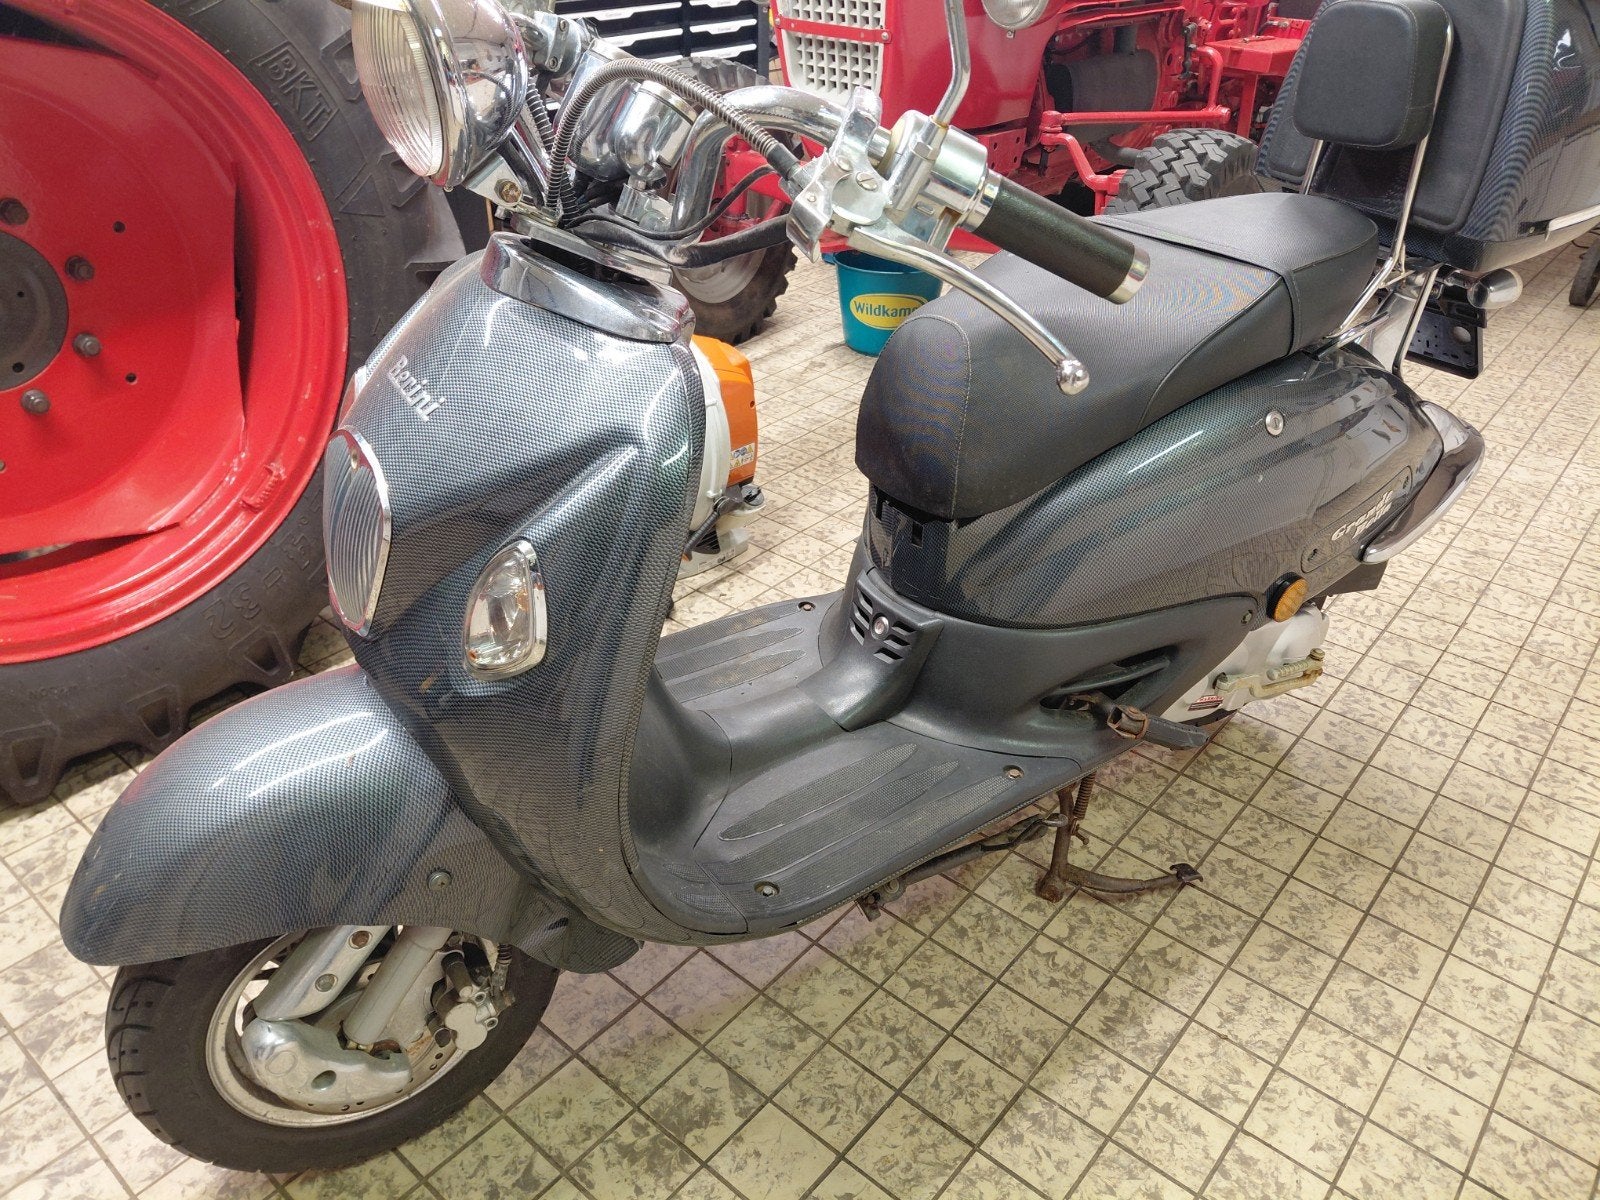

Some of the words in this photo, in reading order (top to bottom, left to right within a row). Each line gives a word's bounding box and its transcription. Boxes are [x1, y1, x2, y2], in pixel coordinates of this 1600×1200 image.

[258, 46, 332, 129] BKT
[853, 300, 919, 318] Wildkam
[388, 354, 446, 422] Berini
